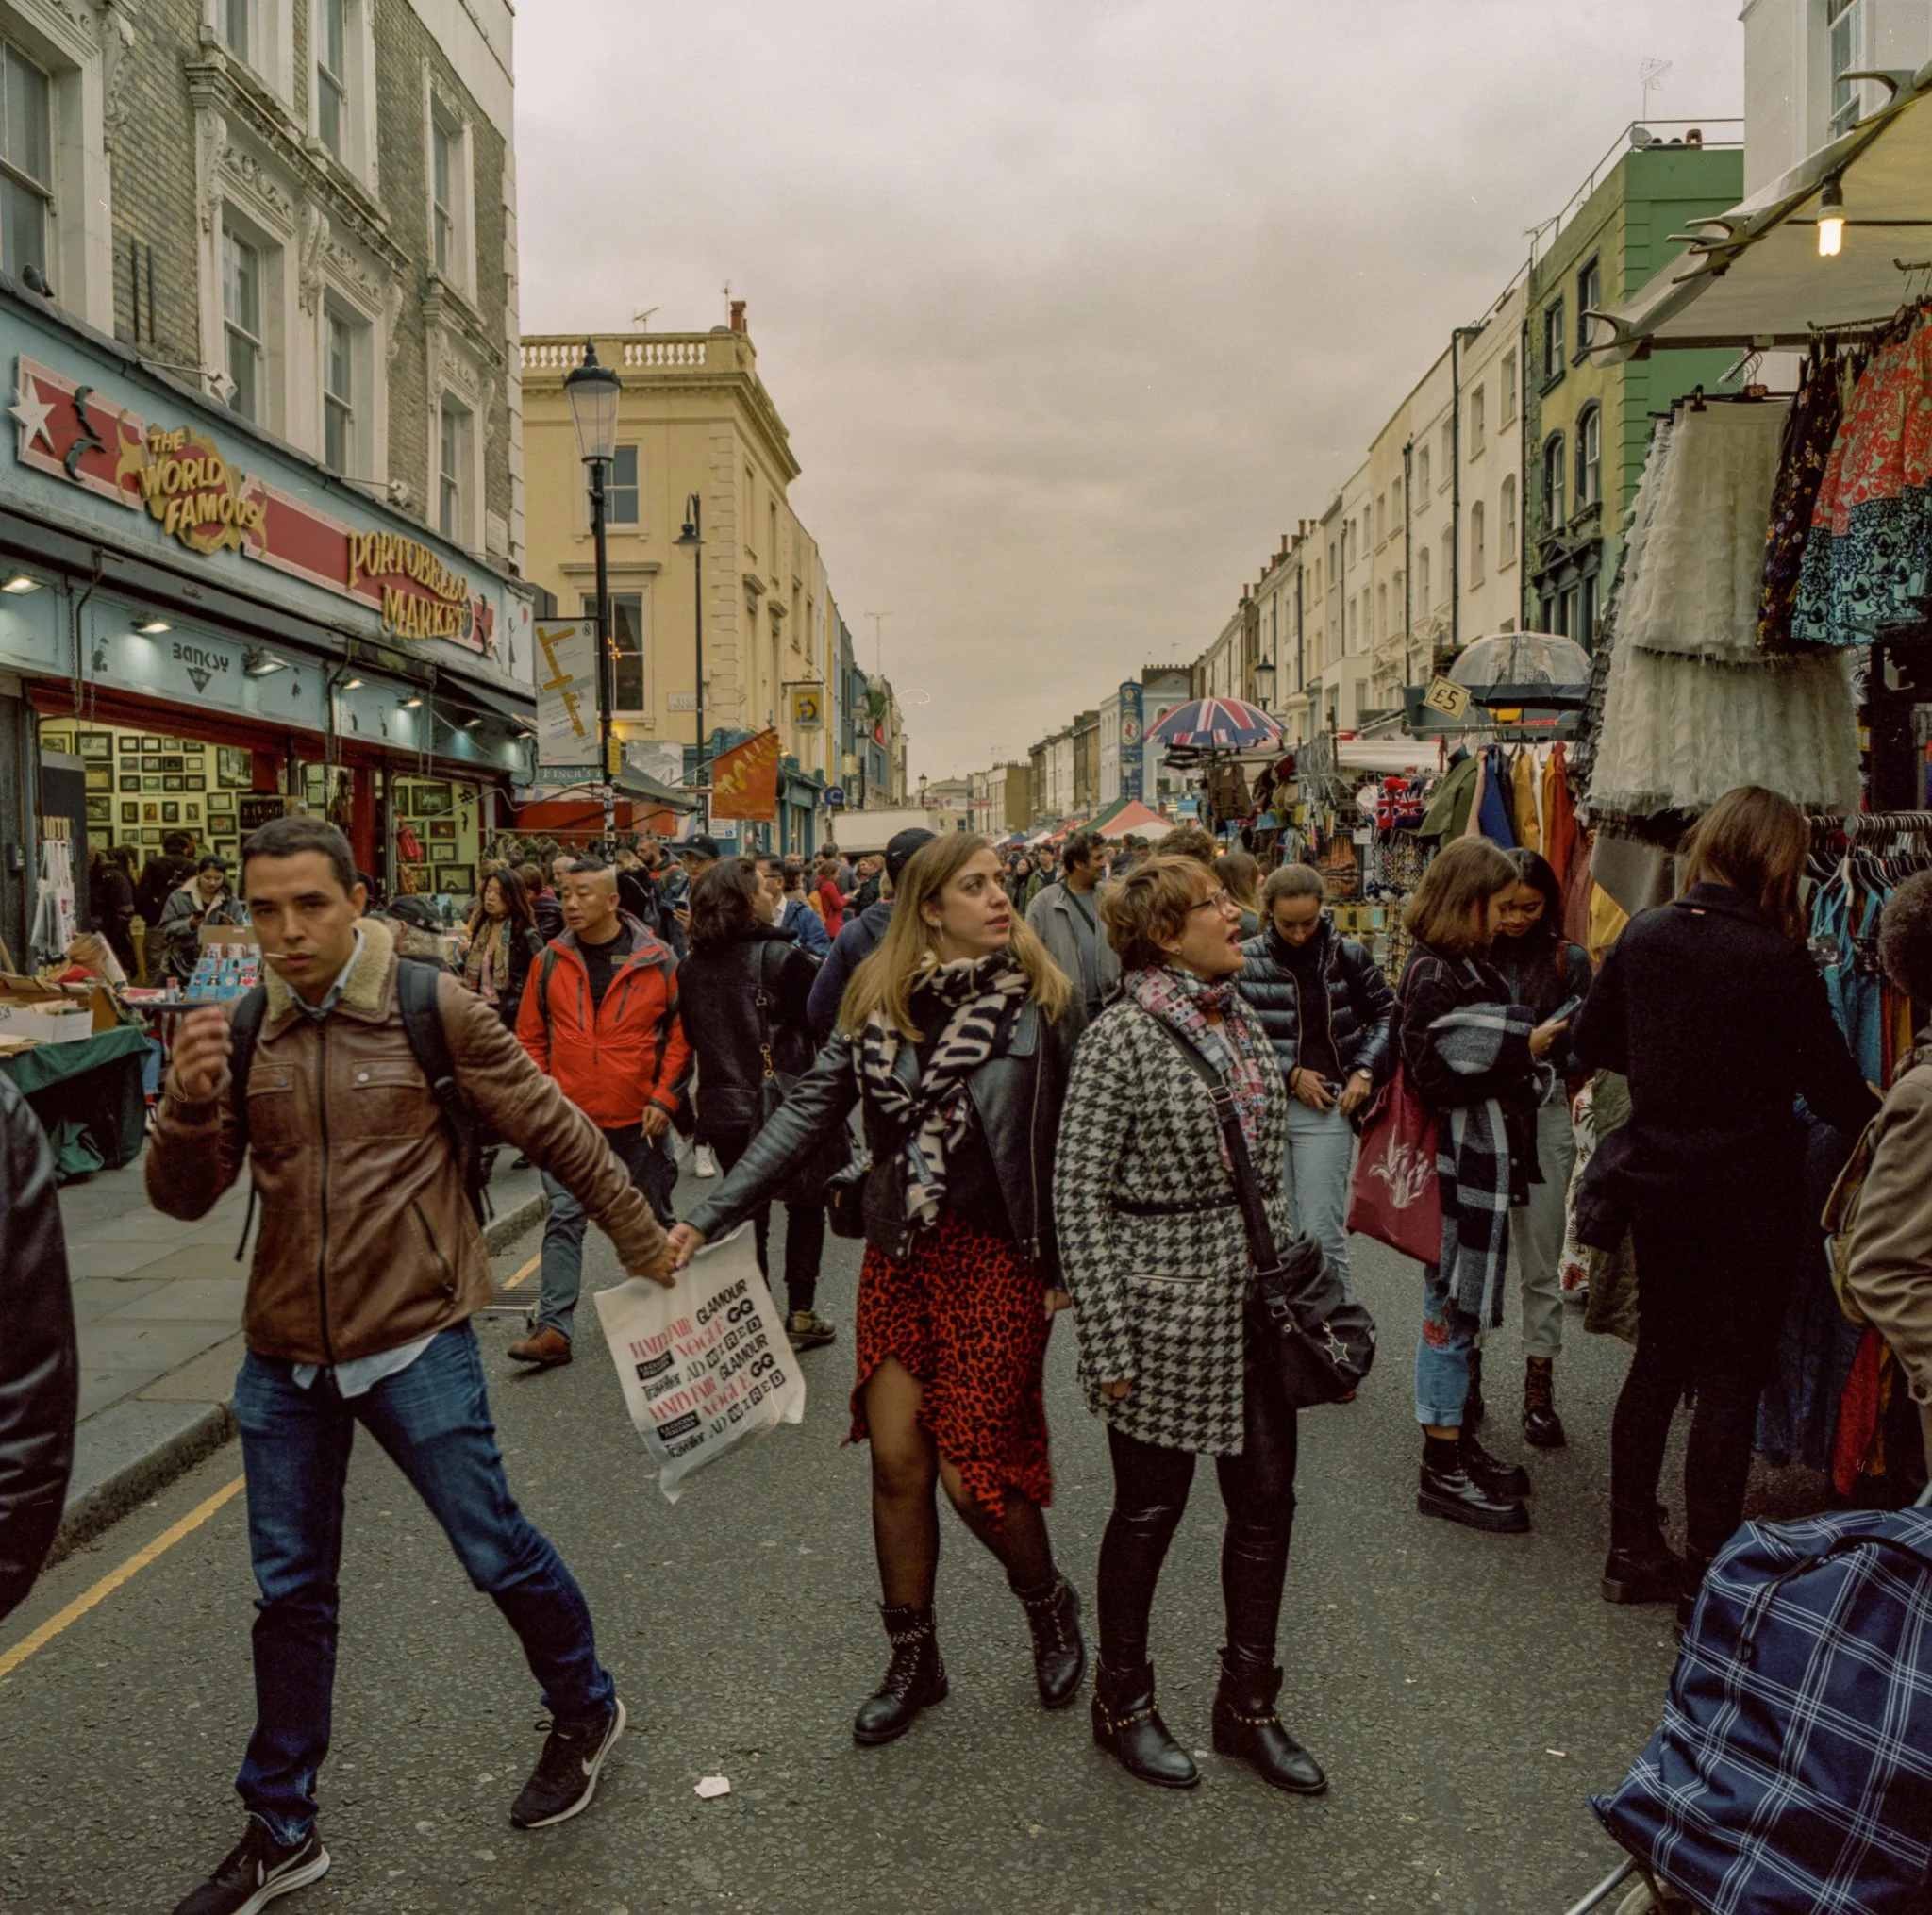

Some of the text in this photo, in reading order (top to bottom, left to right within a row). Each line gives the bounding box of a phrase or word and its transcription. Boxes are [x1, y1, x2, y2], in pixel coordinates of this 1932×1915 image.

[149, 427, 185, 454] THE
[139, 458, 225, 499] WORLD
[163, 491, 261, 536] FAMOUS
[348, 529, 469, 602] PORTOBELLO
[381, 583, 468, 640] MARKET
[1433, 689, 1459, 710] £5
[543, 767, 591, 778] FINCH'S
[696, 1279, 748, 1324] GLAMOUR
[727, 1298, 755, 1323] GQ
[675, 1315, 728, 1358] VOGUE
[705, 1315, 763, 1370] WIRED
[719, 1333, 769, 1381] GLAMOUR
[687, 1360, 707, 1381] AD
[750, 1352, 775, 1378] GQ
[648, 1376, 718, 1423] VANITY FAIR
[702, 1371, 752, 1418] VOGUE
[727, 1369, 787, 1424] WIRED
[709, 1416, 728, 1438] AD
